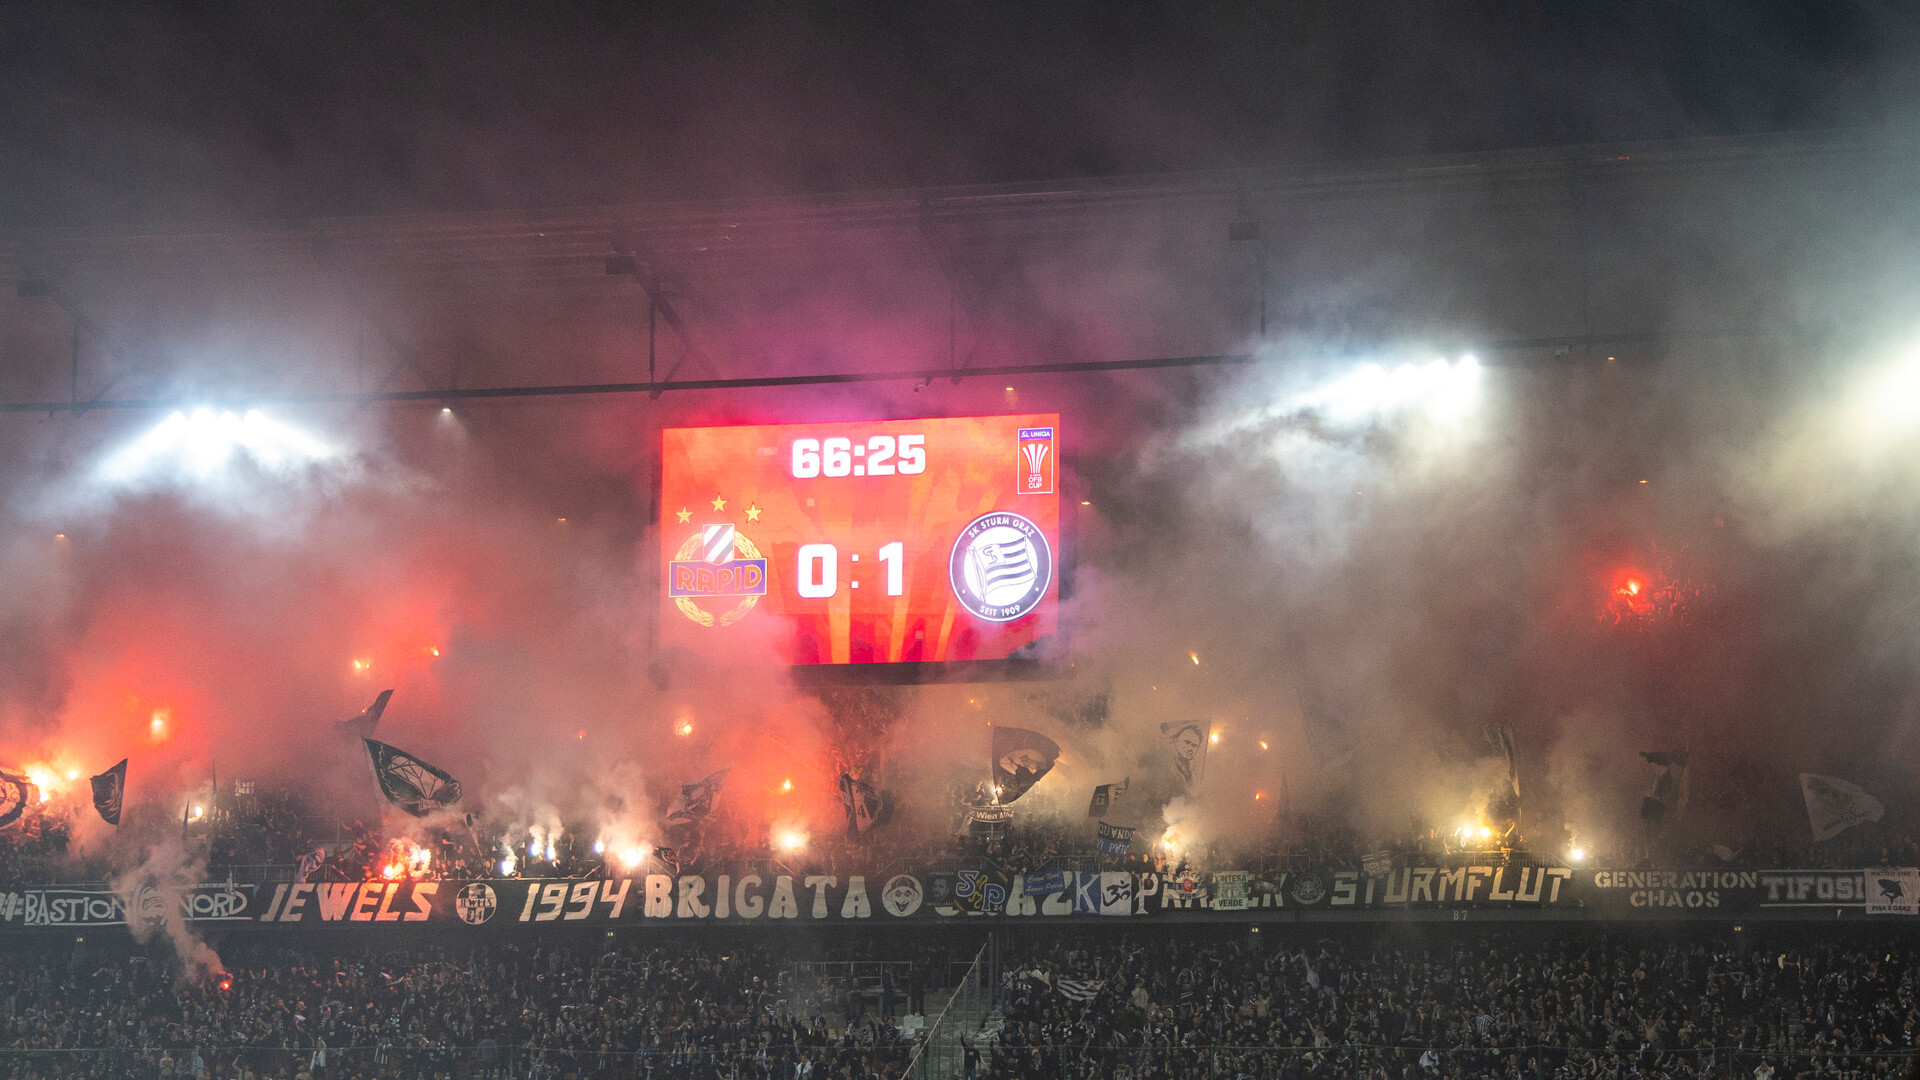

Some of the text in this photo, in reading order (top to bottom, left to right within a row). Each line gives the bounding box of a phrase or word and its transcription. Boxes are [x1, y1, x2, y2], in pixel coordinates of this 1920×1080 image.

[792, 434, 926, 479] 66:25
[968, 516, 1036, 538] SK STURM GRAZ
[676, 564, 763, 593] RAPID
[797, 543, 838, 598] 0
[878, 541, 903, 596] 1
[979, 604, 1021, 617] SEIT 1909
[976, 811, 998, 820] Wien
[1330, 865, 1572, 905] STURMFLUT
[1594, 871, 1757, 889] GENERATION
[1760, 876, 1865, 900] TIFOSI
[259, 882, 440, 922] JEWELS
[518, 878, 632, 922] 1994
[644, 874, 872, 919] BRIGATA
[1218, 899, 1244, 907] VERDE
[1629, 890, 1720, 908] CHAOS
